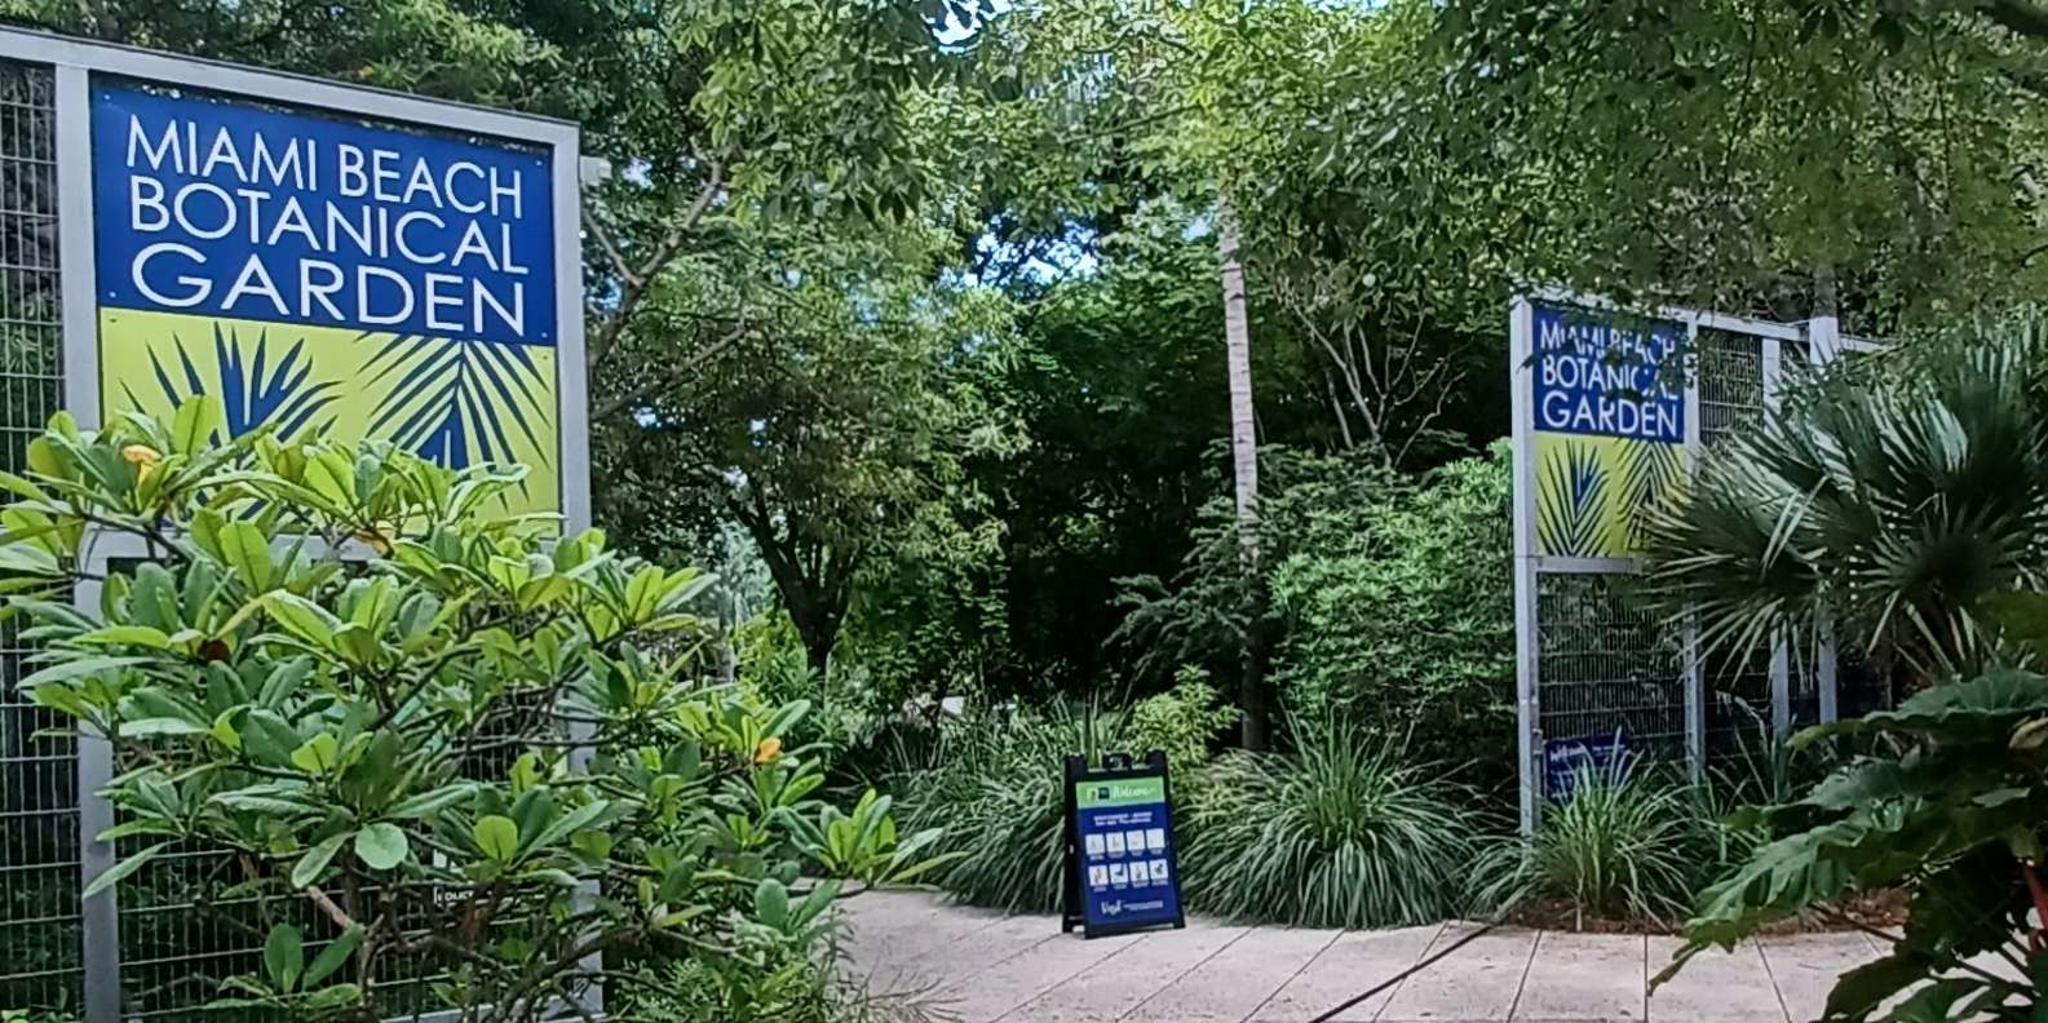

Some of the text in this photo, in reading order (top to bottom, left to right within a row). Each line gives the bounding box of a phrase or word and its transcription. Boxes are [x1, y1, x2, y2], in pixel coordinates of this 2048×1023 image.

[127, 113, 523, 219] MIAMI BEACH
[130, 175, 529, 275] BOTANICAL
[131, 242, 525, 337] GARDEN
[1540, 319, 1605, 359] MIAMI
[1542, 390, 1678, 437] GARDEN
